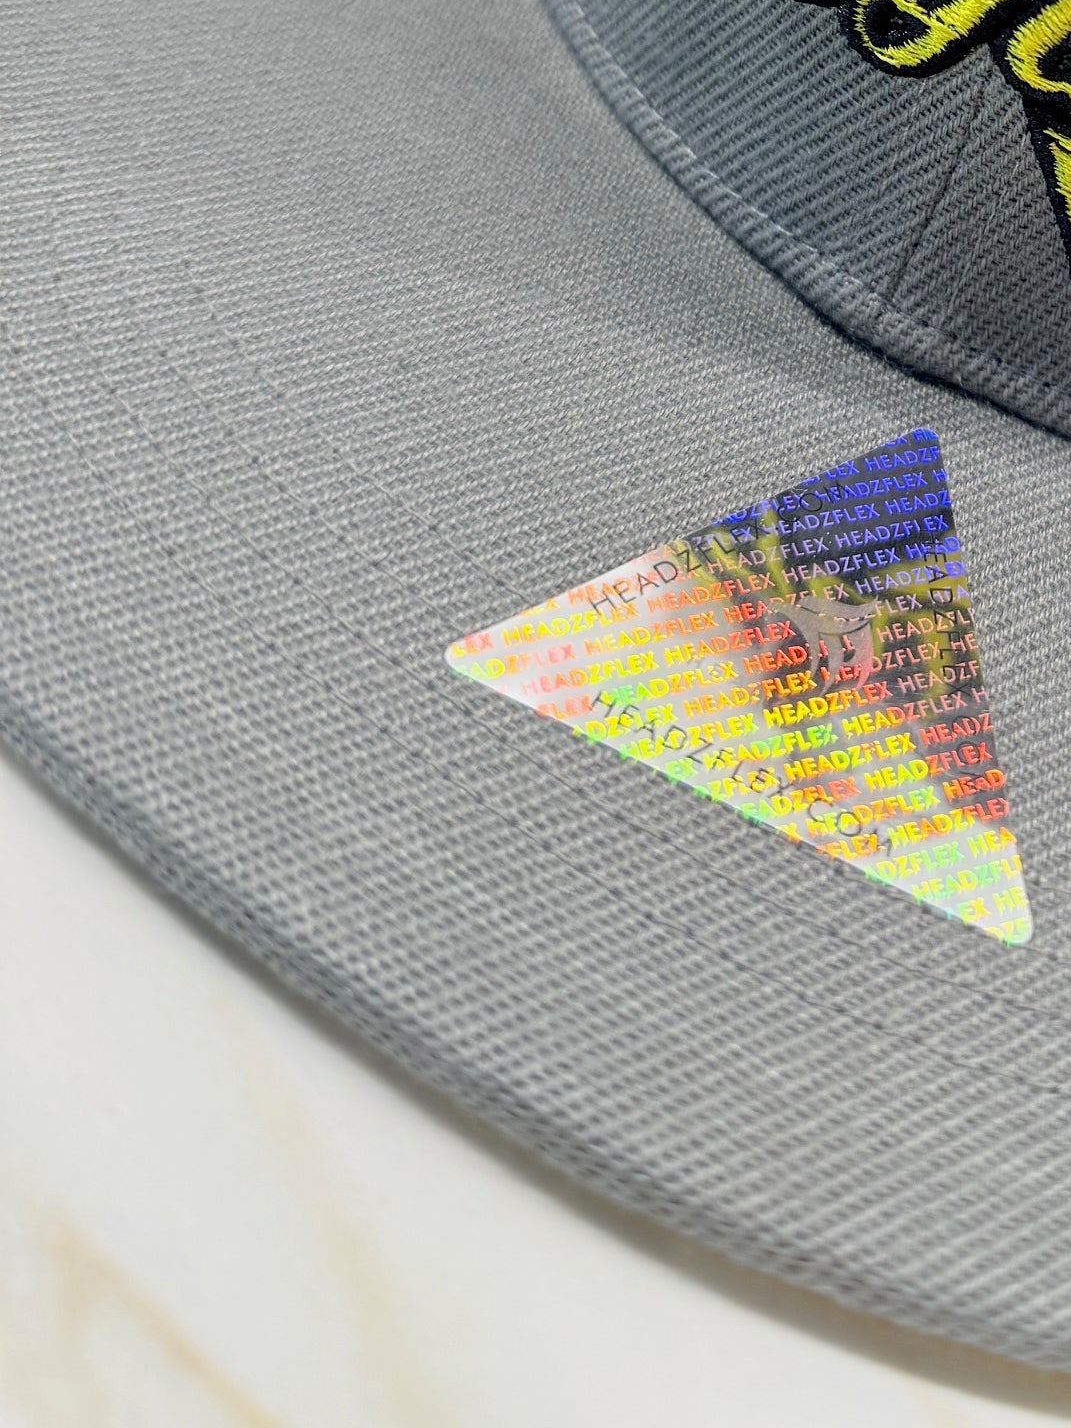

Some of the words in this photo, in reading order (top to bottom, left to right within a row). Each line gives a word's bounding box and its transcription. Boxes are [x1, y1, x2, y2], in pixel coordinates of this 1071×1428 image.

[705, 536, 829, 574] HEADZFLEX
[501, 602, 640, 647] HEADZFLEX
[646, 571, 775, 613] HEADZFLEX
[782, 547, 901, 584] HEADZFLEX
[519, 650, 658, 696] HEADZFLEX
[663, 619, 796, 666] HEADZFLEX
[583, 609, 719, 656] HEADZFLEX
[600, 659, 738, 709] HEADZFLEX
[762, 679, 893, 728] HEADZFLEX
[840, 689, 967, 738] HEADZFLEX
[782, 731, 917, 783] HEADZFLEX
[863, 740, 993, 791] HEADZFLEX
